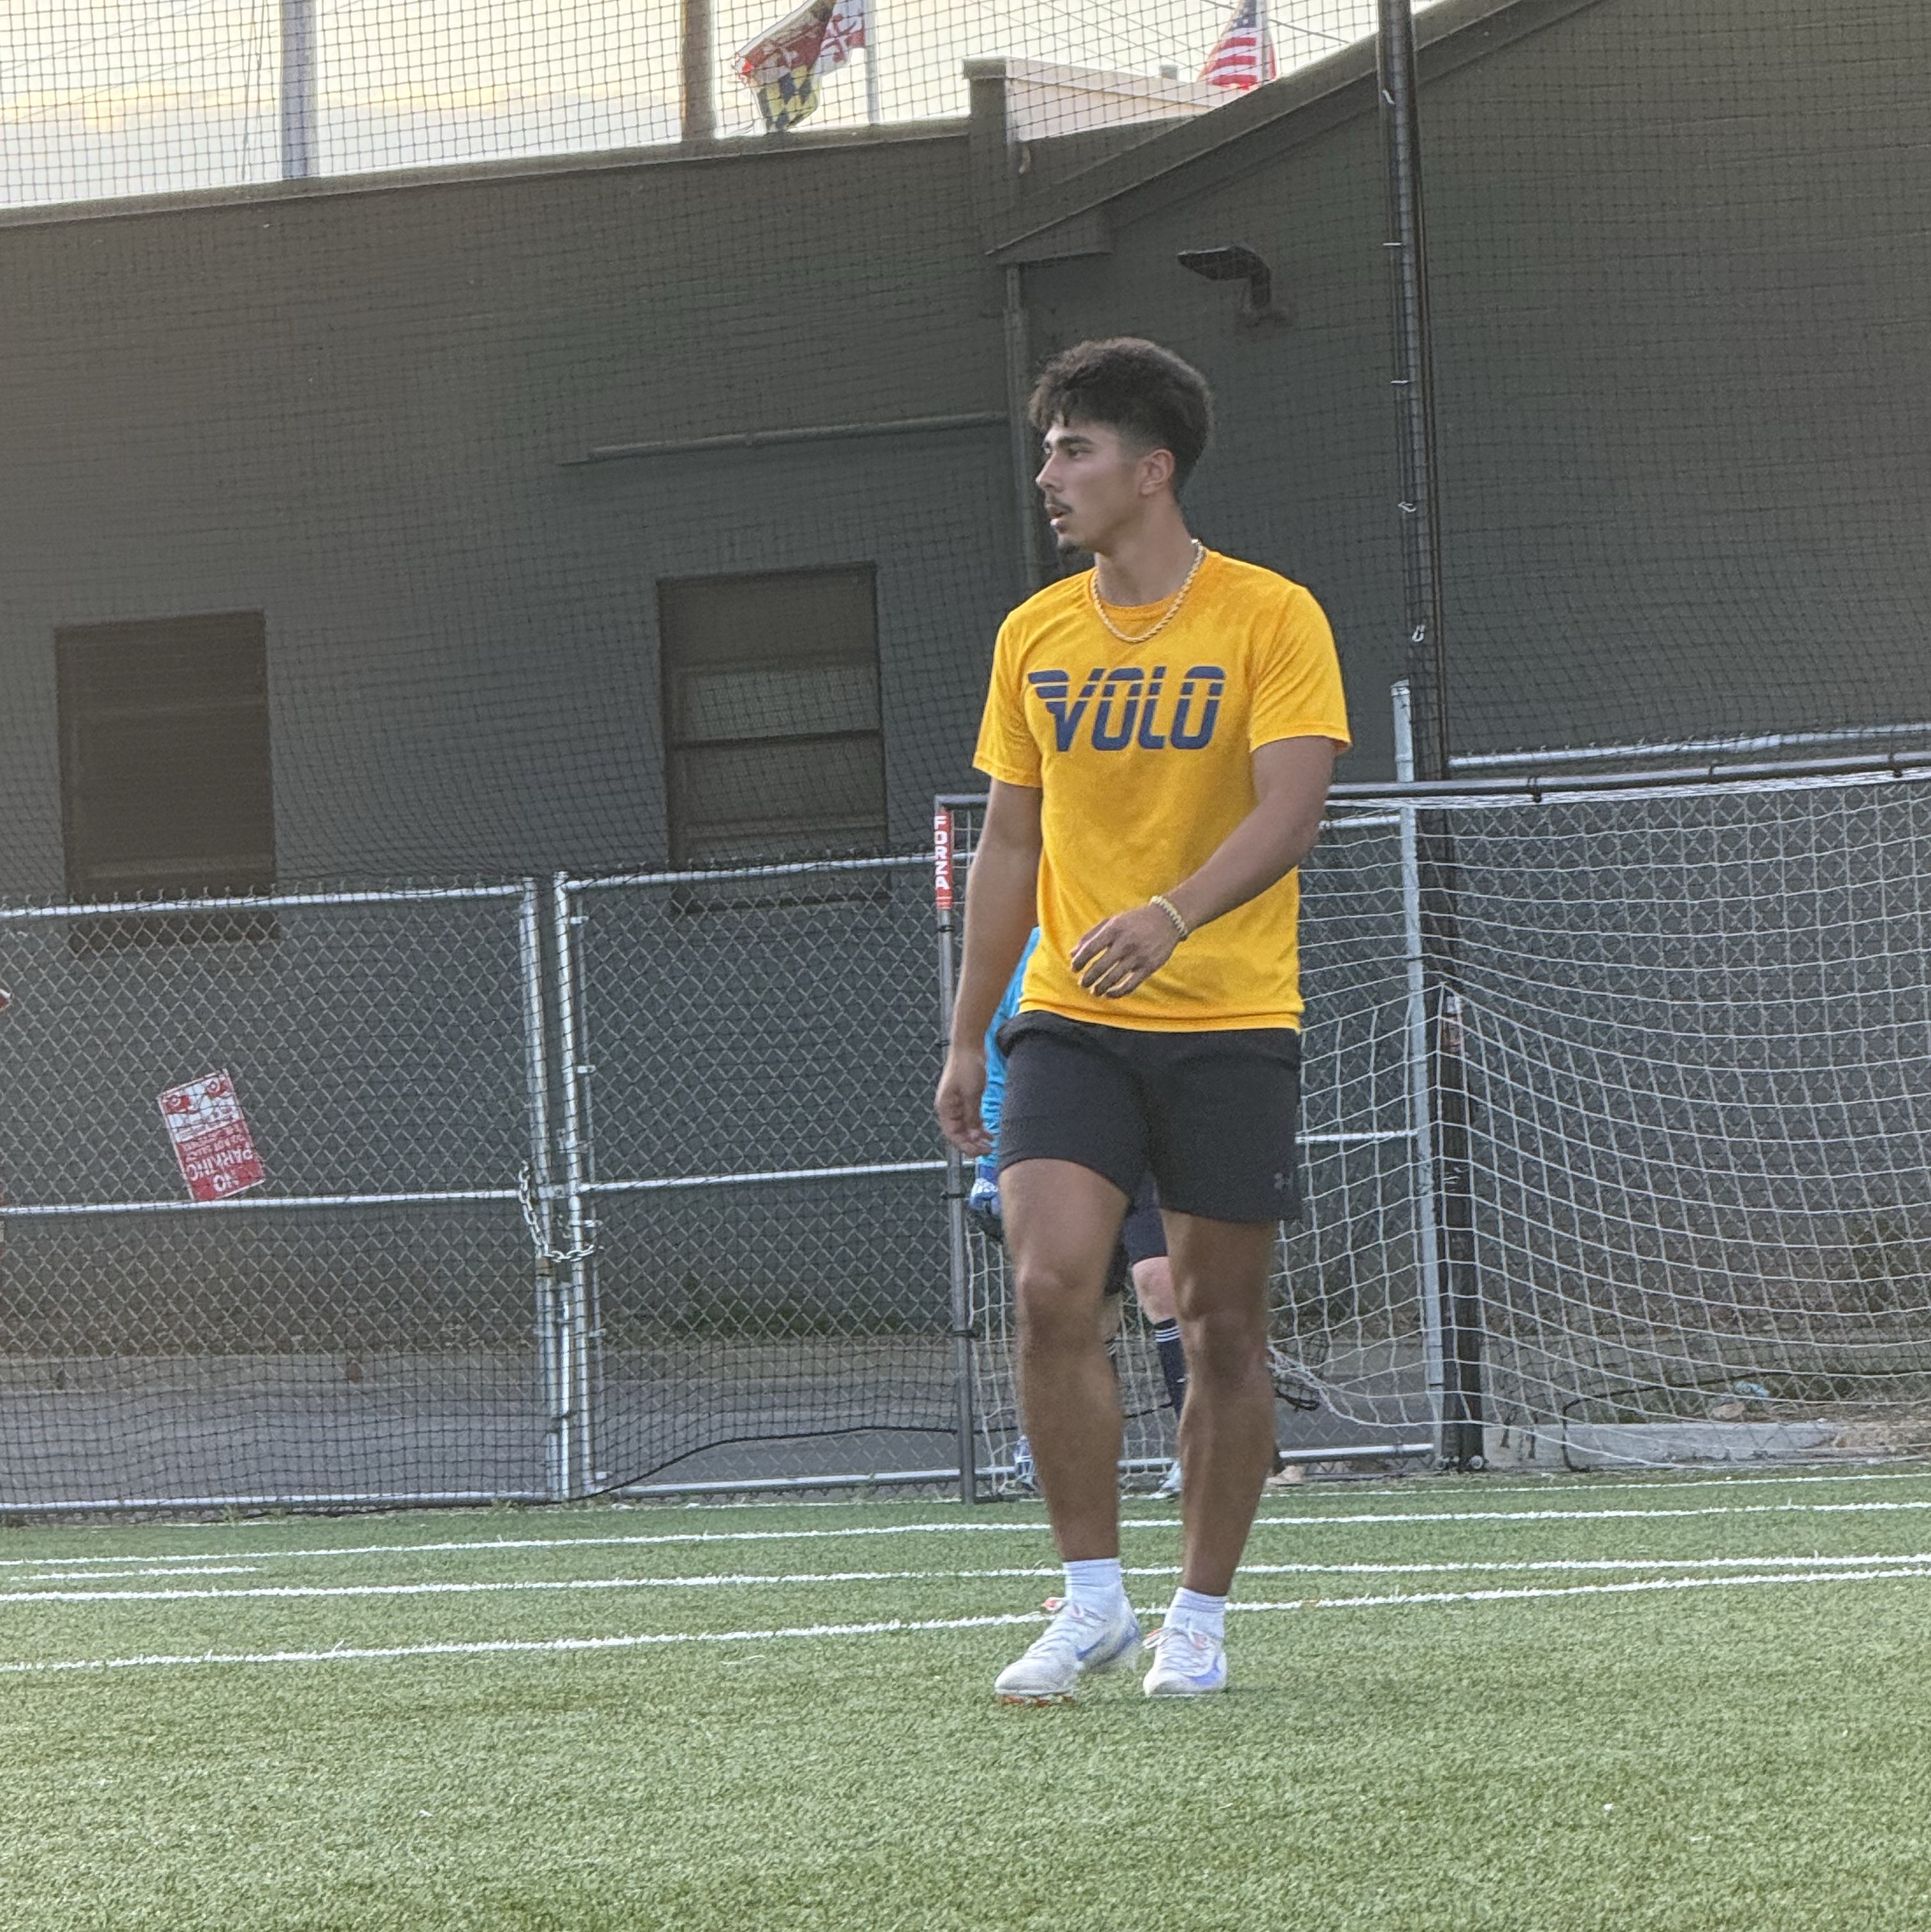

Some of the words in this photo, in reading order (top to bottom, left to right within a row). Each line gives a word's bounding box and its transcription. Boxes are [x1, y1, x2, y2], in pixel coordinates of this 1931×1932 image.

[1028, 666, 1225, 752] VOLO
[934, 815, 950, 890] FORZA
[213, 1169, 239, 1192] NO
